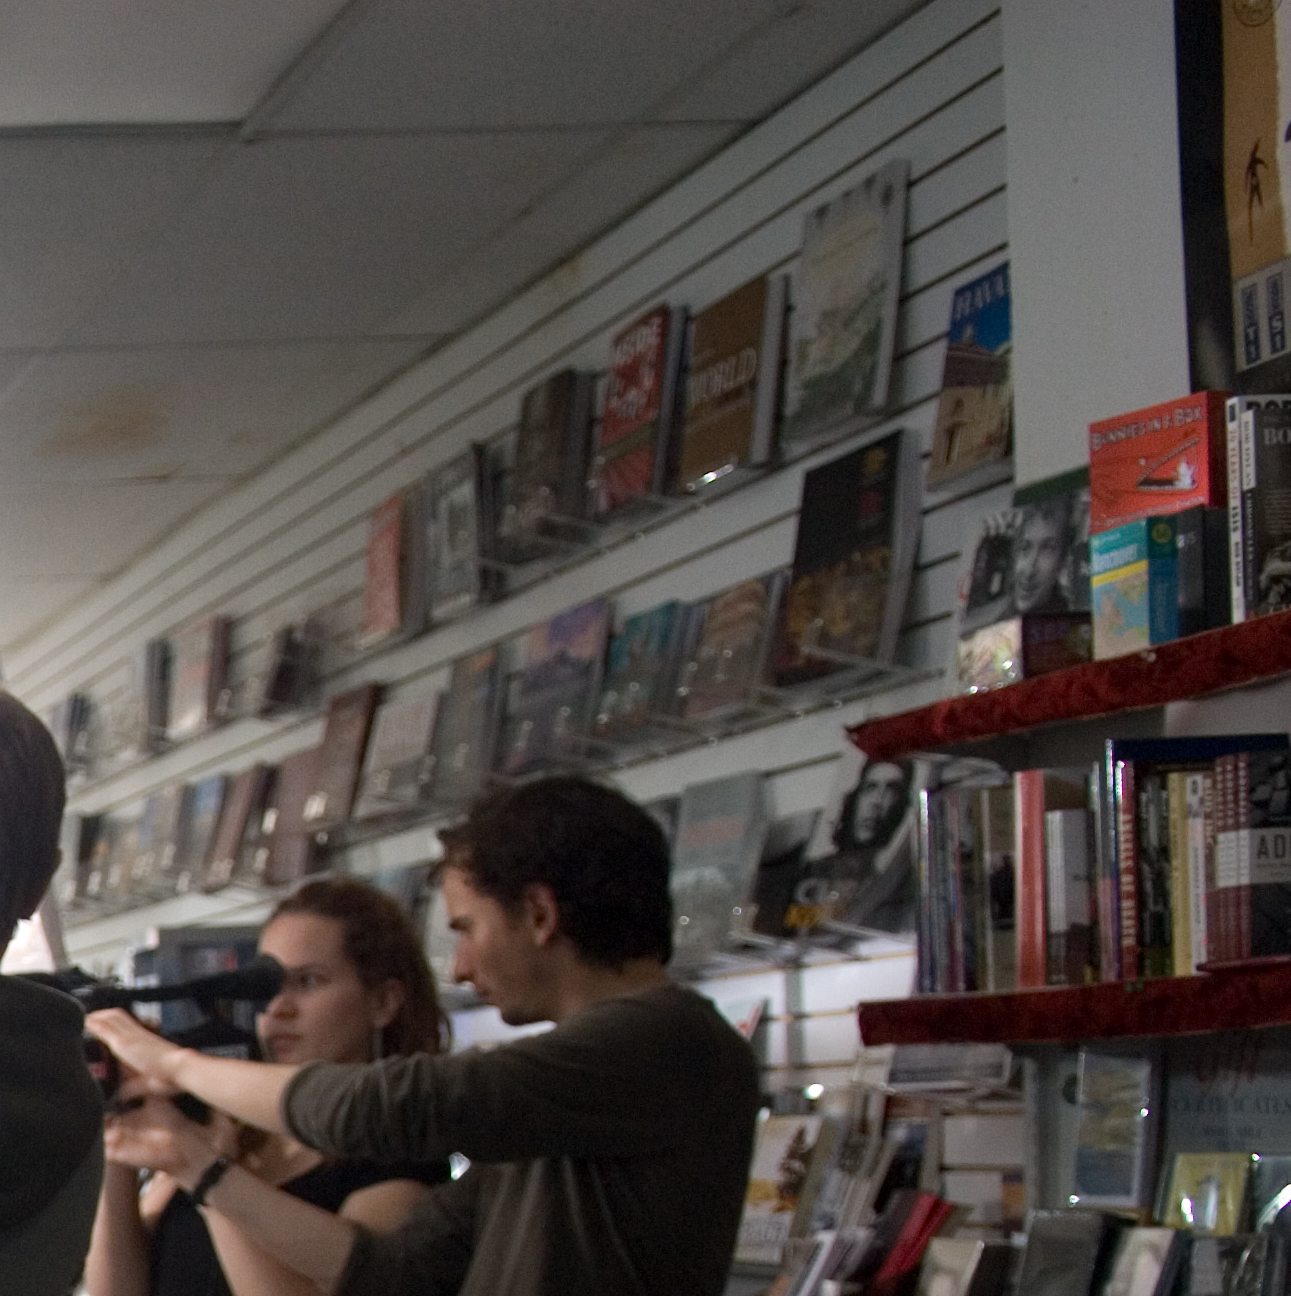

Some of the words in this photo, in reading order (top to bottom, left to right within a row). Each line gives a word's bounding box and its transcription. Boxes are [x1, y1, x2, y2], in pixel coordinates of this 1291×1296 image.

[1091, 422, 1146, 451] BUNNIES
[1147, 417, 1162, 432] IN
[1174, 406, 1202, 427] BOX
[1120, 812, 1136, 871] ANGELS
[1121, 873, 1136, 893] OF
[1121, 897, 1137, 947] DEATH
